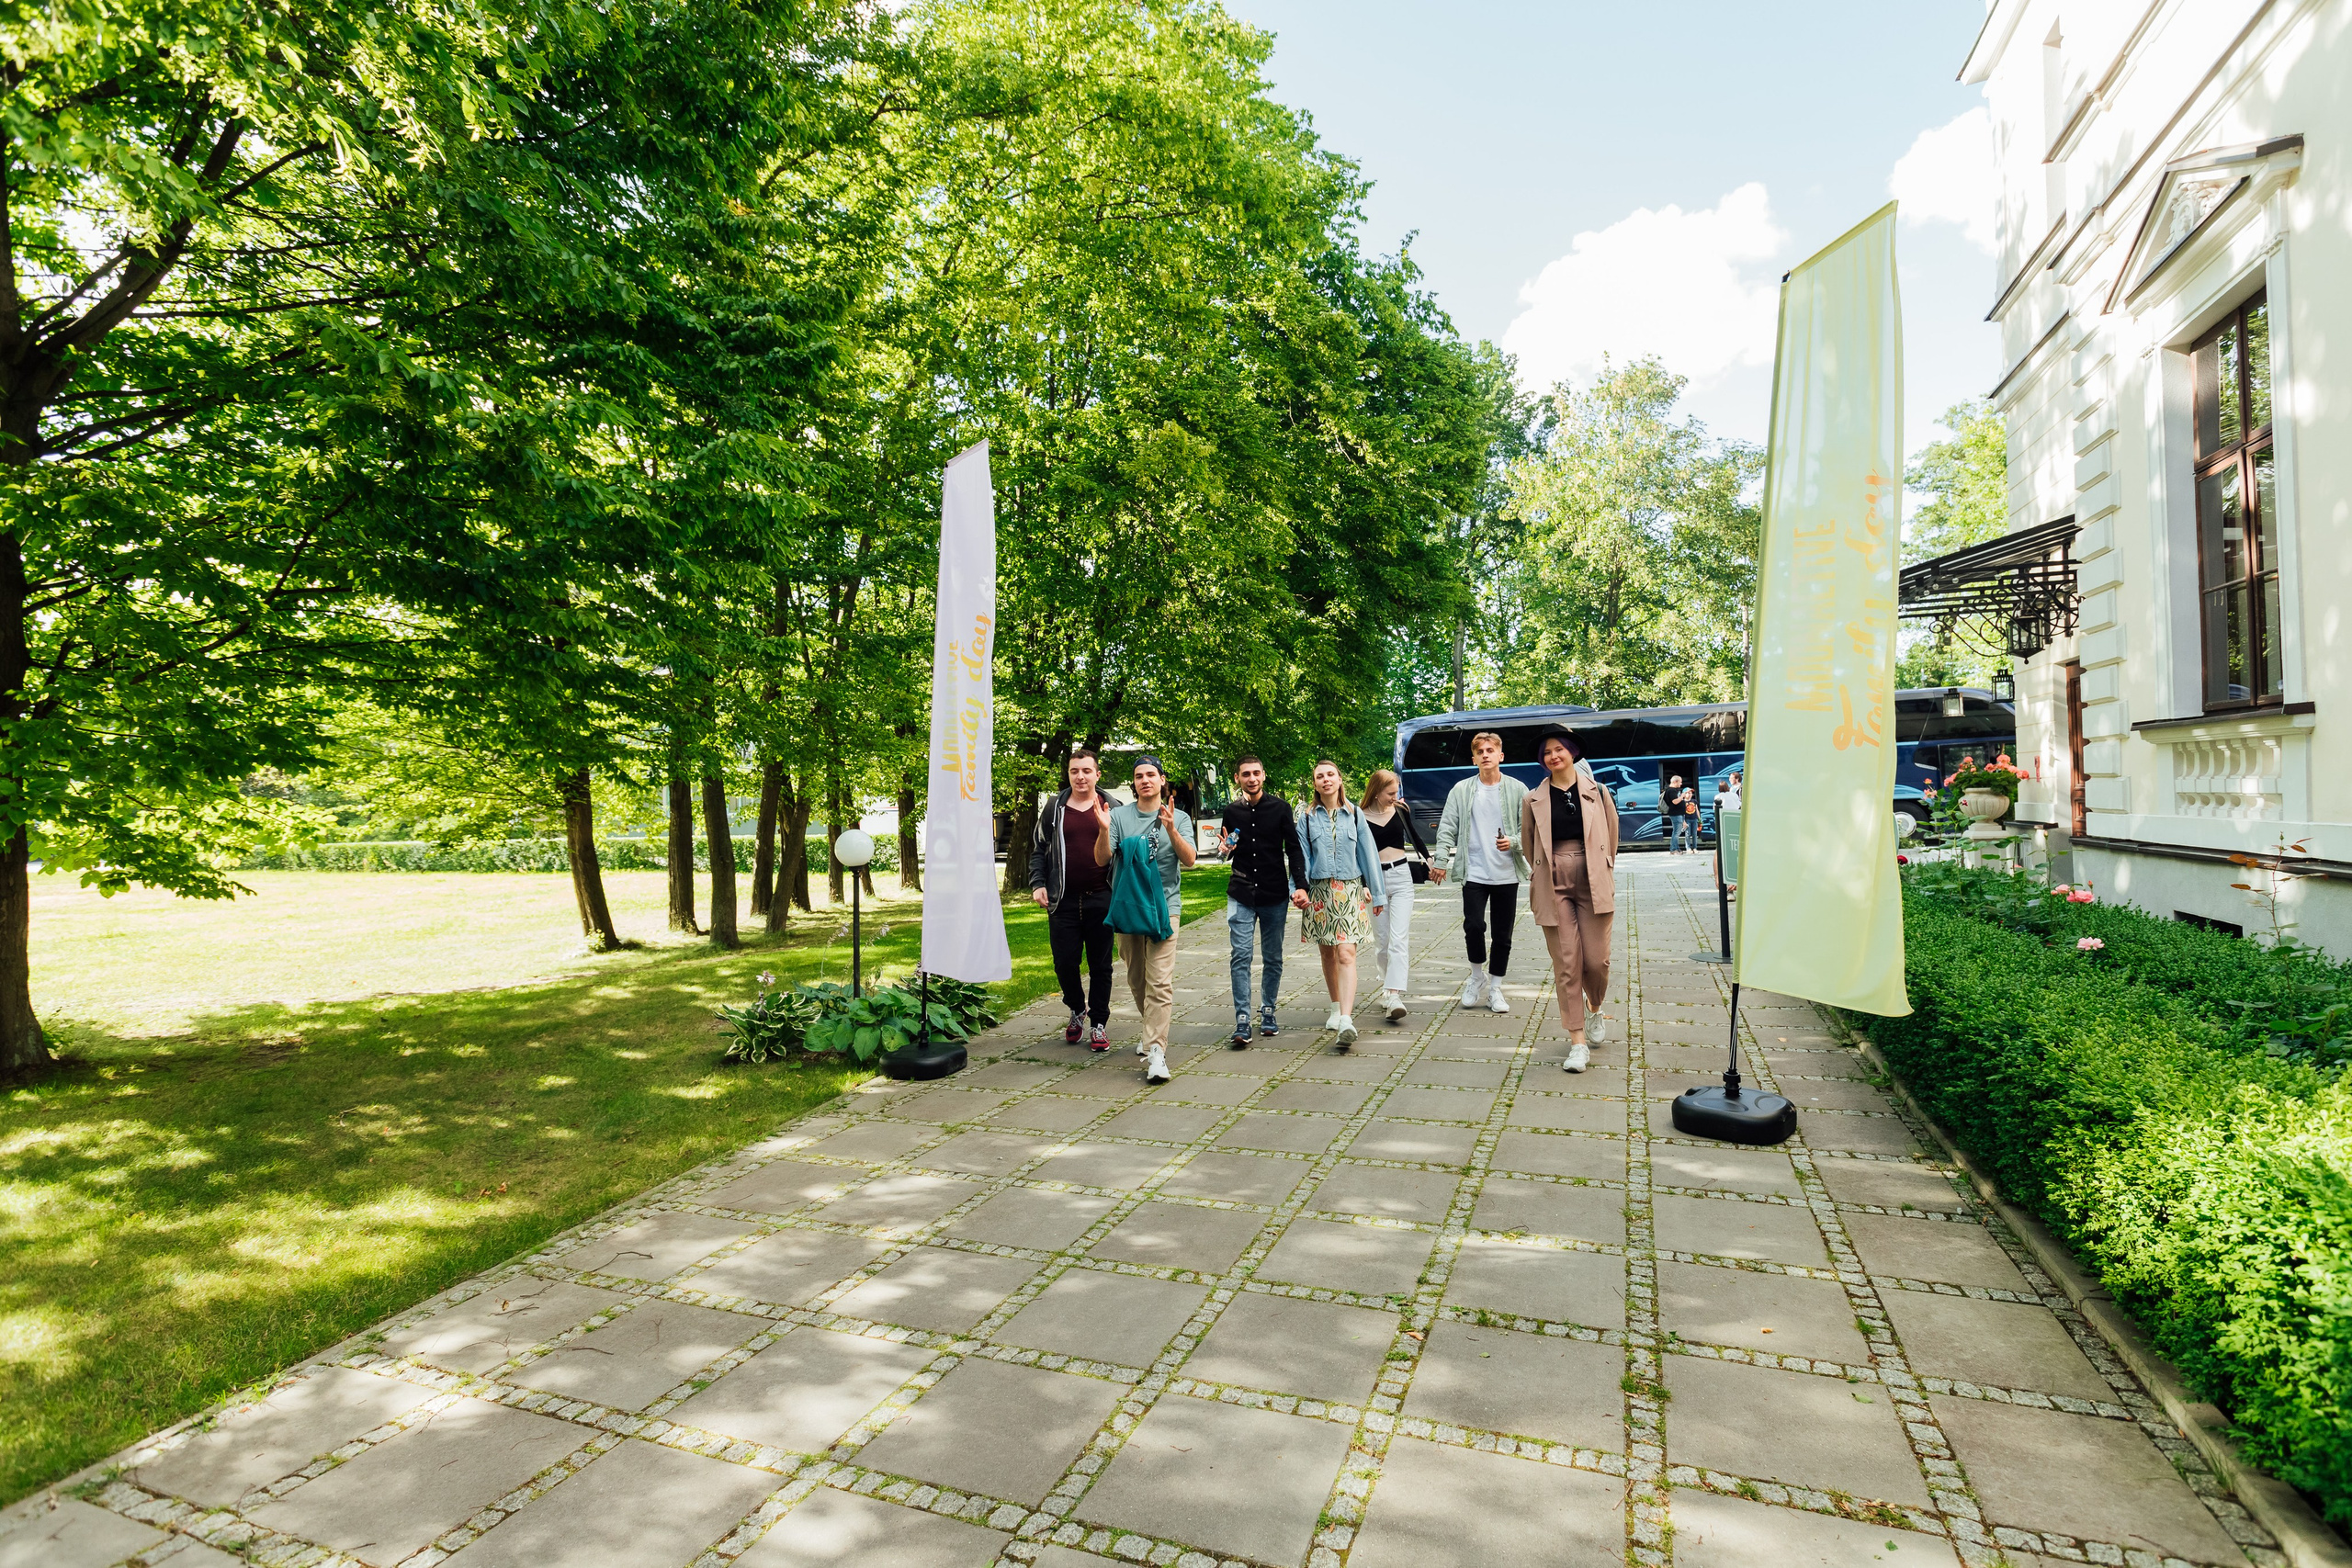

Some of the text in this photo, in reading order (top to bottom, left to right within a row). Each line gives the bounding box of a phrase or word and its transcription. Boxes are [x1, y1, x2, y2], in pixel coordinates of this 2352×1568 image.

[1845, 468, 1894, 572] day
[960, 611, 991, 801] Family day
